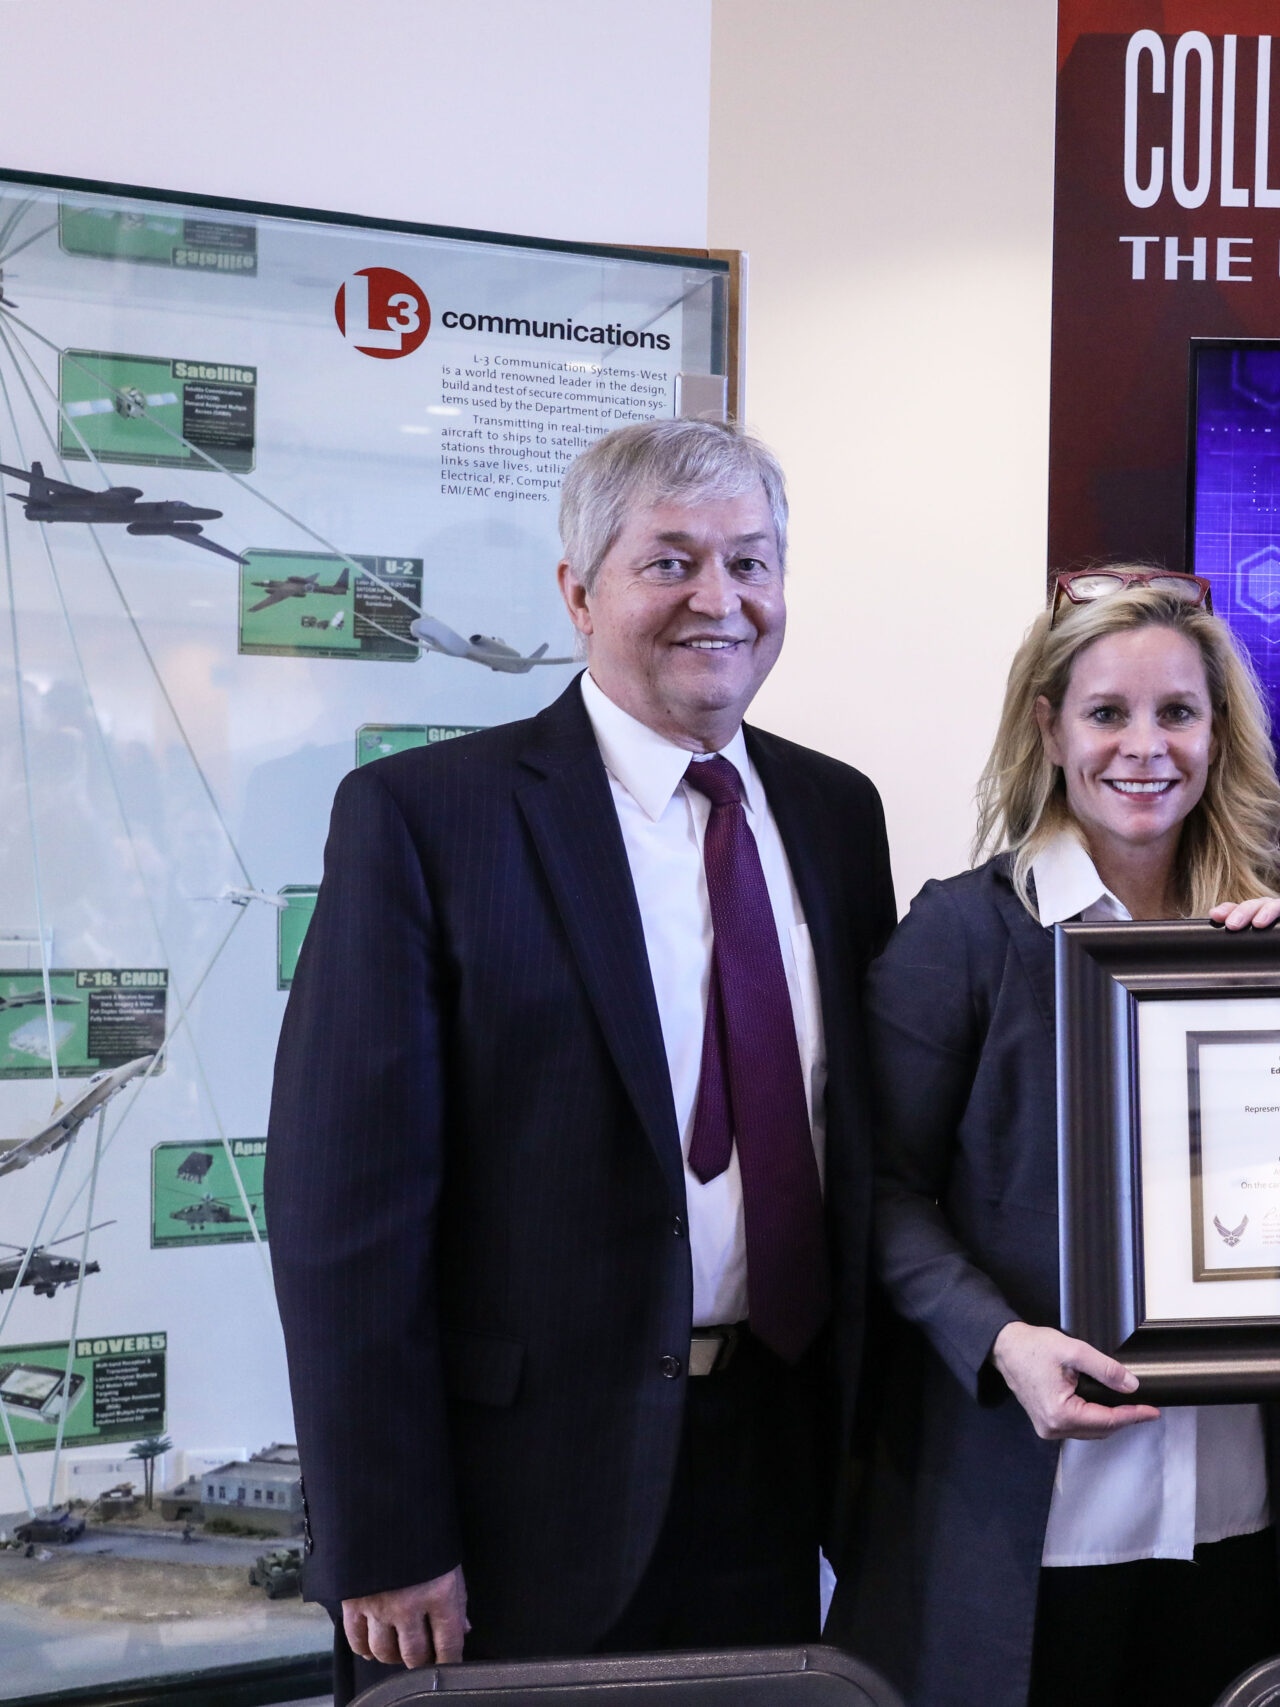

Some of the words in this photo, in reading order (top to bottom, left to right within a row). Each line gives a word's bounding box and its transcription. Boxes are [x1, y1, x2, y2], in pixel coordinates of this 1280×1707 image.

[1119, 235, 1253, 283] THE
[441, 310, 671, 351] communications
[175, 363, 254, 383] Satellite
[473, 354, 489, 366] L-3
[494, 355, 586, 374] Communication
[591, 364, 667, 381] Systems-West
[442, 366, 451, 375] is
[455, 368, 461, 376] a
[465, 368, 497, 379] world
[501, 372, 555, 385] renowned
[559, 375, 592, 388] leader
[595, 380, 606, 390] in
[609, 381, 627, 391] the
[630, 383, 667, 397] design,
[442, 379, 470, 391] build
[471, 383, 492, 393] and
[494, 384, 514, 395] test
[516, 386, 527, 396] of
[528, 389, 563, 399] secure
[564, 391, 646, 407] communication
[648, 400, 667, 411] sys-
[441, 394, 469, 405] tems
[472, 398, 497, 408] used
[500, 398, 512, 412] by
[515, 400, 533, 411] the
[535, 402, 599, 417] Department
[600, 408, 612, 418] of
[473, 414, 544, 432] Transmitting
[547, 420, 558, 431] in
[441, 427, 482, 439] aircraft
[487, 431, 499, 440] to
[502, 432, 532, 445] ships
[536, 435, 547, 445] to
[441, 442, 485, 454] stations
[489, 445, 551, 460] throughout
[554, 450, 572, 461] the
[441, 455, 469, 467] links
[473, 460, 499, 470] save
[503, 460, 532, 473] lives,
[536, 463, 567, 475] utiliz
[441, 470, 496, 484] Electrical,
[498, 474, 513, 486] RF,
[516, 476, 563, 489] Comput
[441, 485, 491, 498] EMI/EMC
[385, 560, 414, 575] U-2
[77, 972, 118, 986] F-18:
[120, 971, 166, 987] CMDL
[1240, 1181, 1253, 1190] On
[77, 1334, 166, 1357] ROVER5
